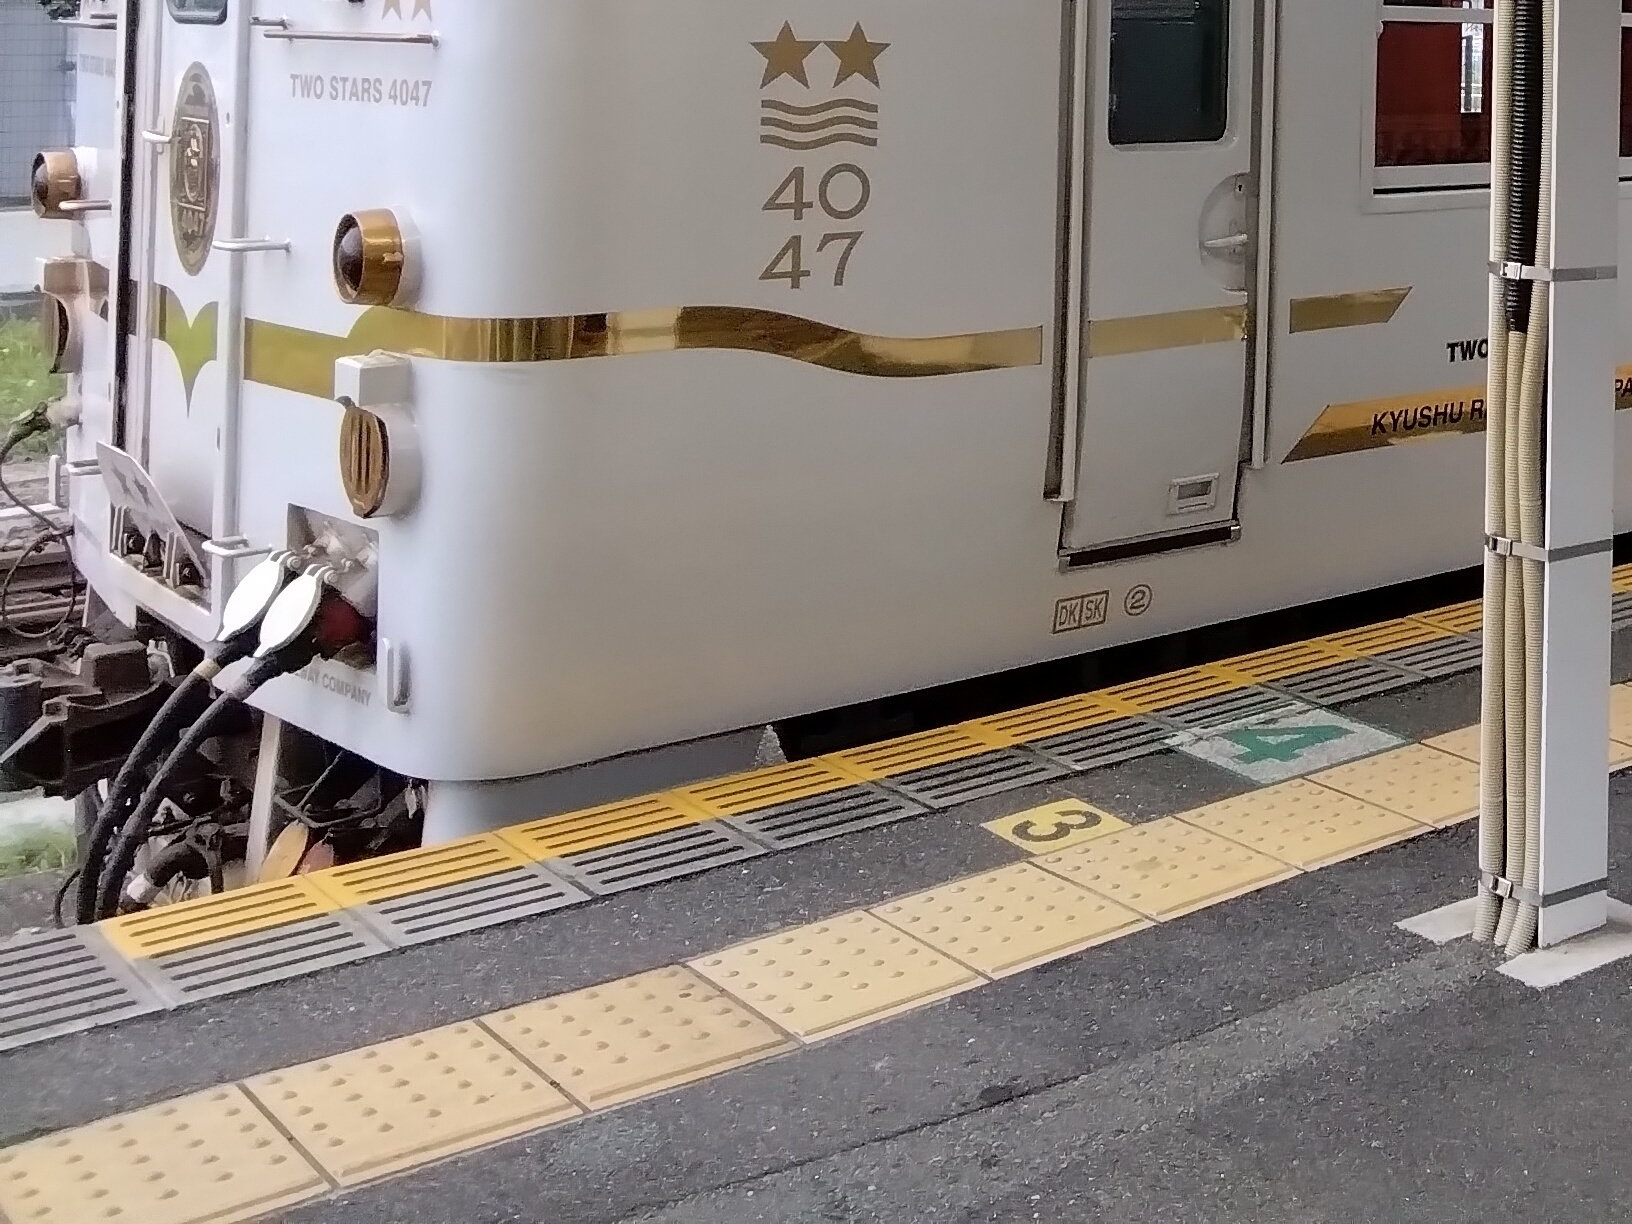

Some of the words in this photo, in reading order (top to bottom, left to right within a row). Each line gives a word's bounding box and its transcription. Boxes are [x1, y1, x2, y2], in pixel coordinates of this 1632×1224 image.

[290, 73, 325, 100] TWO
[329, 75, 383, 104] STARS
[388, 78, 433, 107] 4047
[761, 163, 871, 221] 40
[758, 231, 865, 289] 47
[1370, 400, 1464, 435] KYUSHU
[1011, 809, 1102, 843] 3
